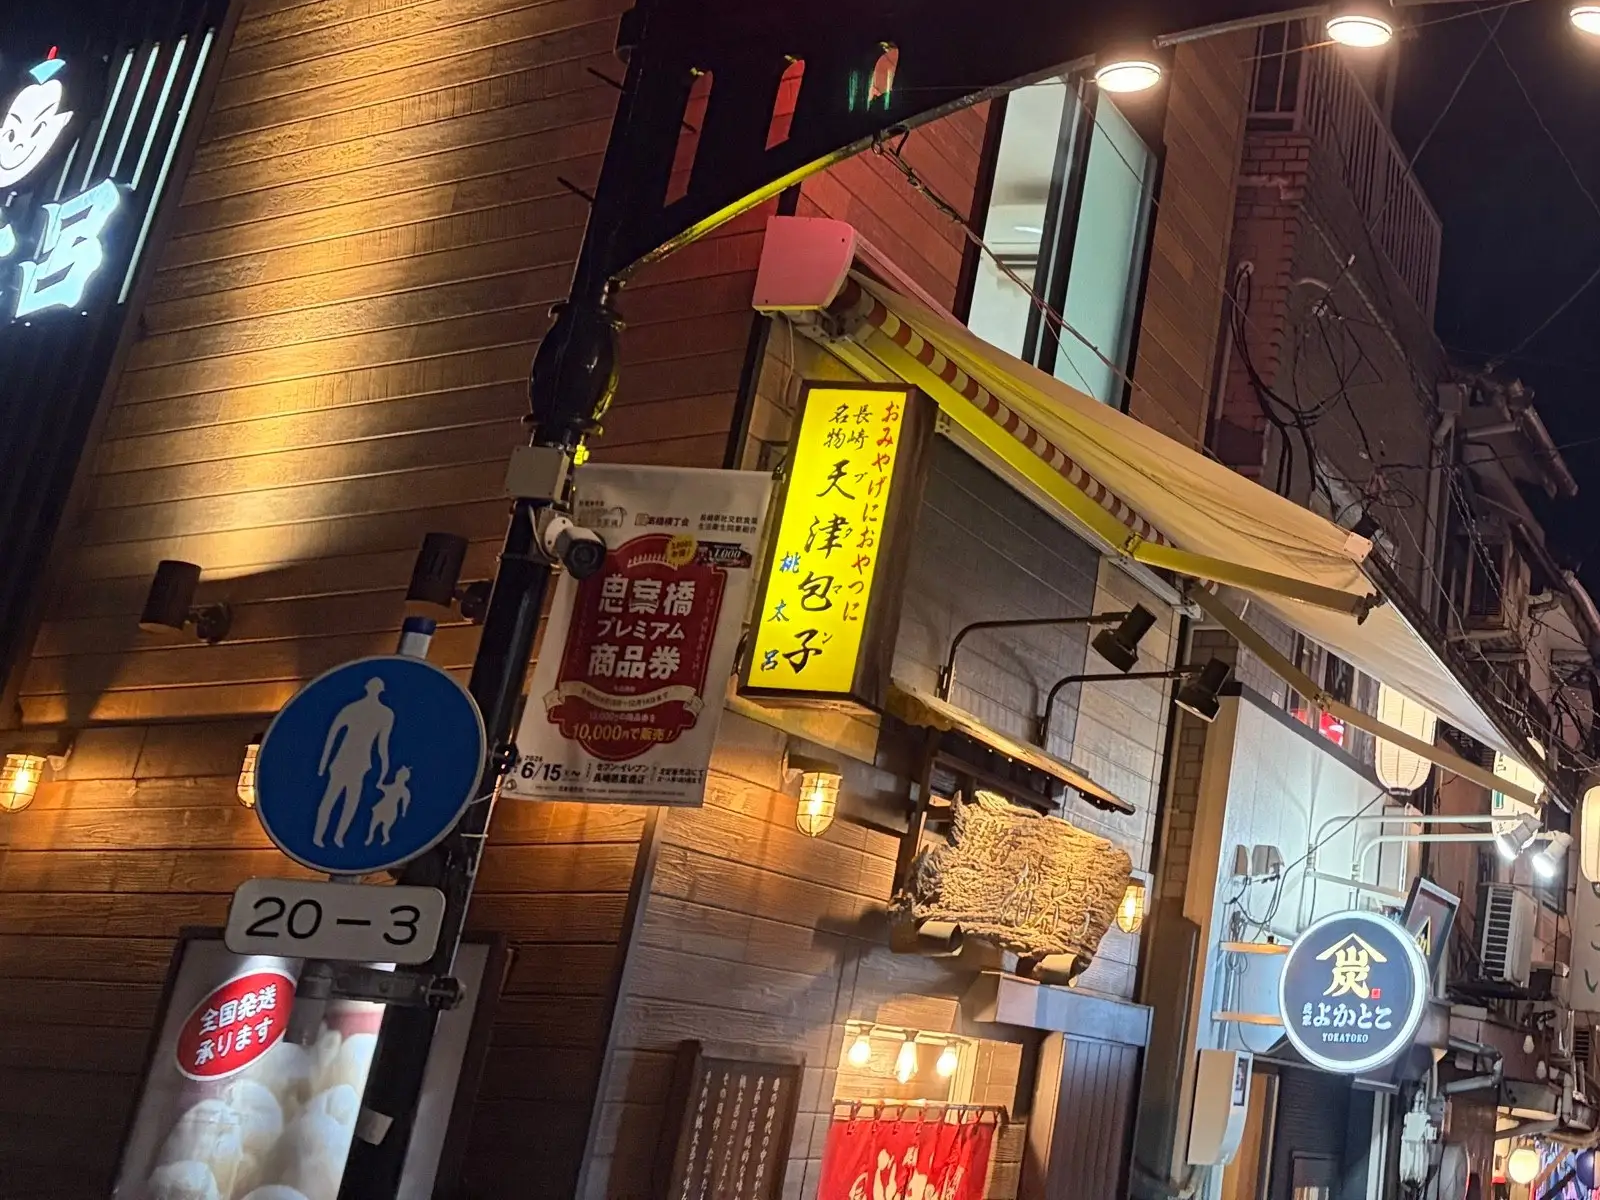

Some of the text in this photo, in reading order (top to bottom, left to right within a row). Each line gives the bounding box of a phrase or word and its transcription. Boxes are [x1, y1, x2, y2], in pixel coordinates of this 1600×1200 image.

[823, 403, 849, 449] 名物
[846, 404, 874, 450] 長崎
[842, 401, 899, 623] おみやげにおやつに
[782, 459, 856, 675] 天津包子
[598, 573, 696, 617] 思案橋
[760, 551, 802, 673] 桃太呂
[597, 616, 685, 641] プレミアム
[587, 642, 681, 680] 商品券
[245, 896, 422, 946] 20-3
[1321, 944, 1371, 999] 炭
[199, 983, 278, 1036] 全国発送
[1312, 1001, 1393, 1031] よかとこ
[193, 1017, 274, 1067] 承ります
[1321, 1032, 1370, 1044] YOKATOKO
